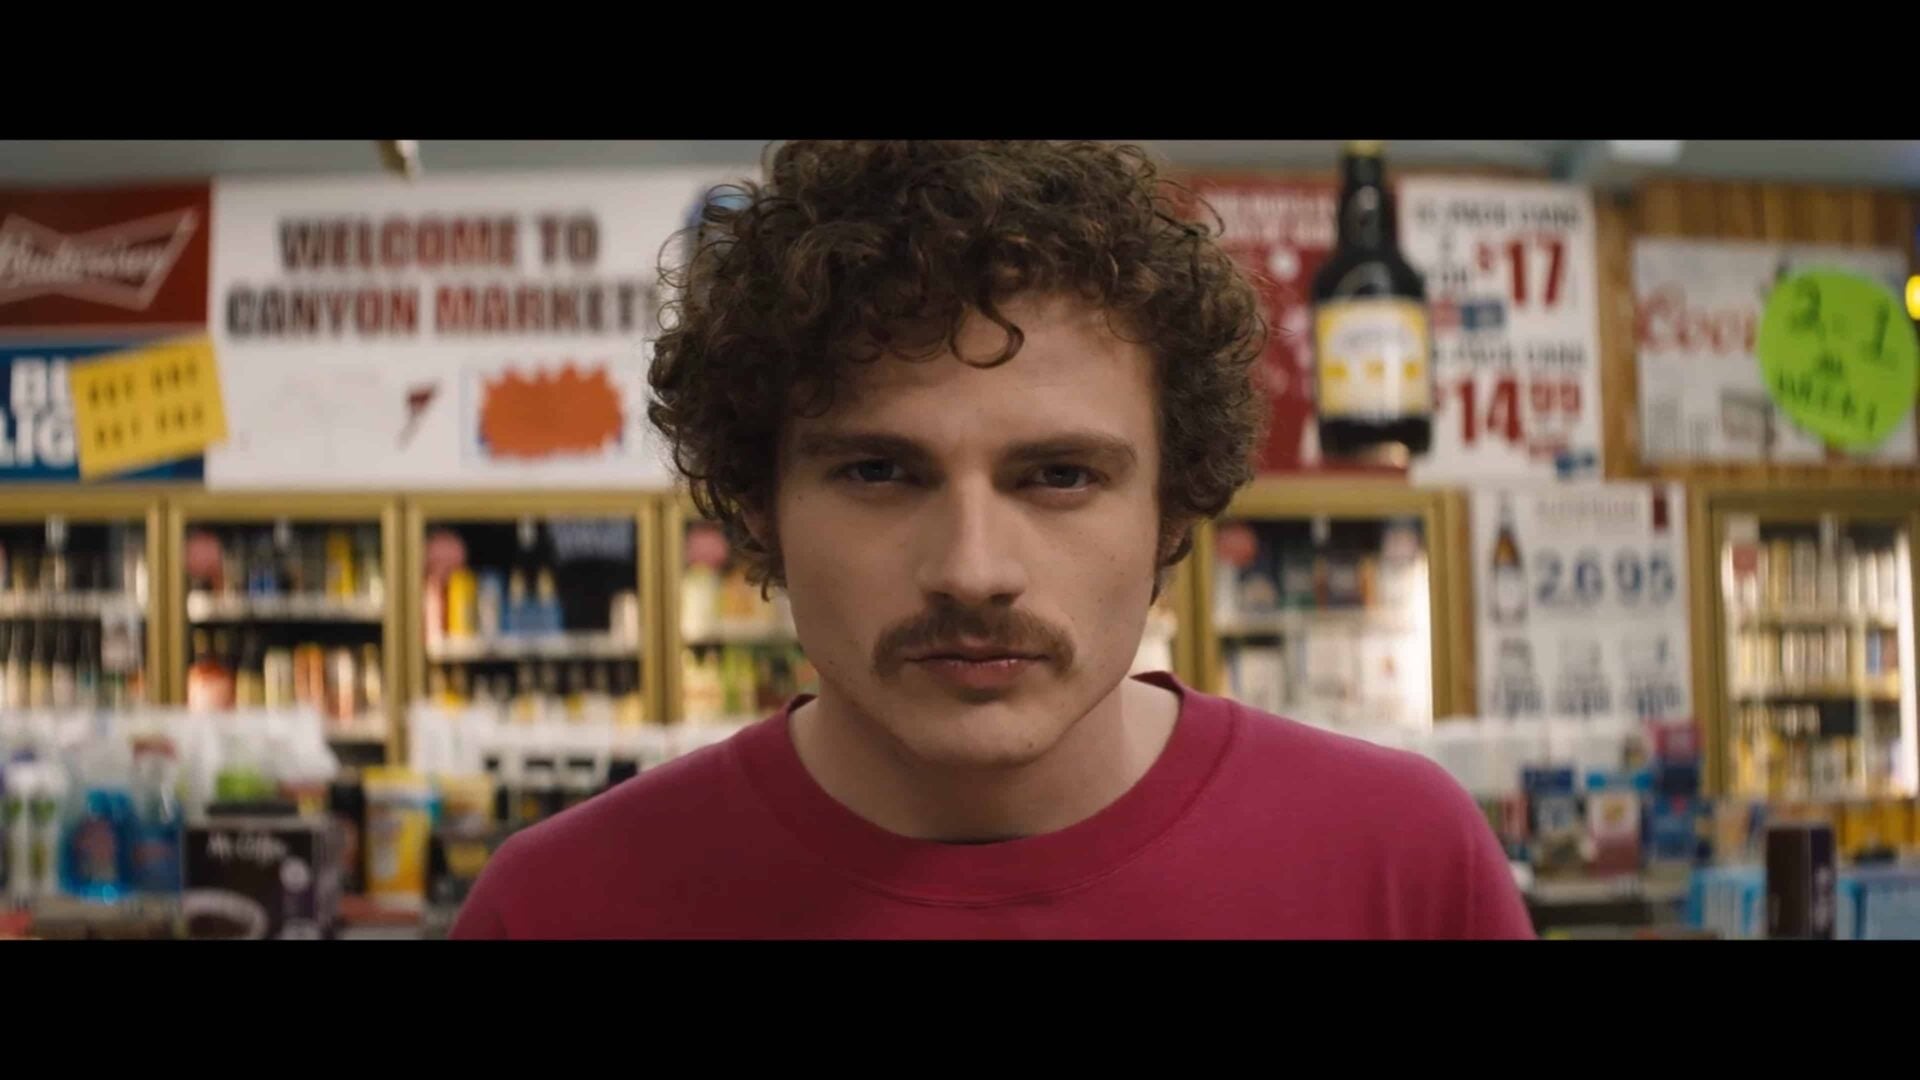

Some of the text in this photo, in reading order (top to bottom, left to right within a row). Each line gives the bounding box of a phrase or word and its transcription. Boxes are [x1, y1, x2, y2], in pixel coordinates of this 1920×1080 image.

[278, 212, 599, 271] WELCOME TO
[226, 282, 418, 338] CANYON
[0, 408, 75, 466] LIG
